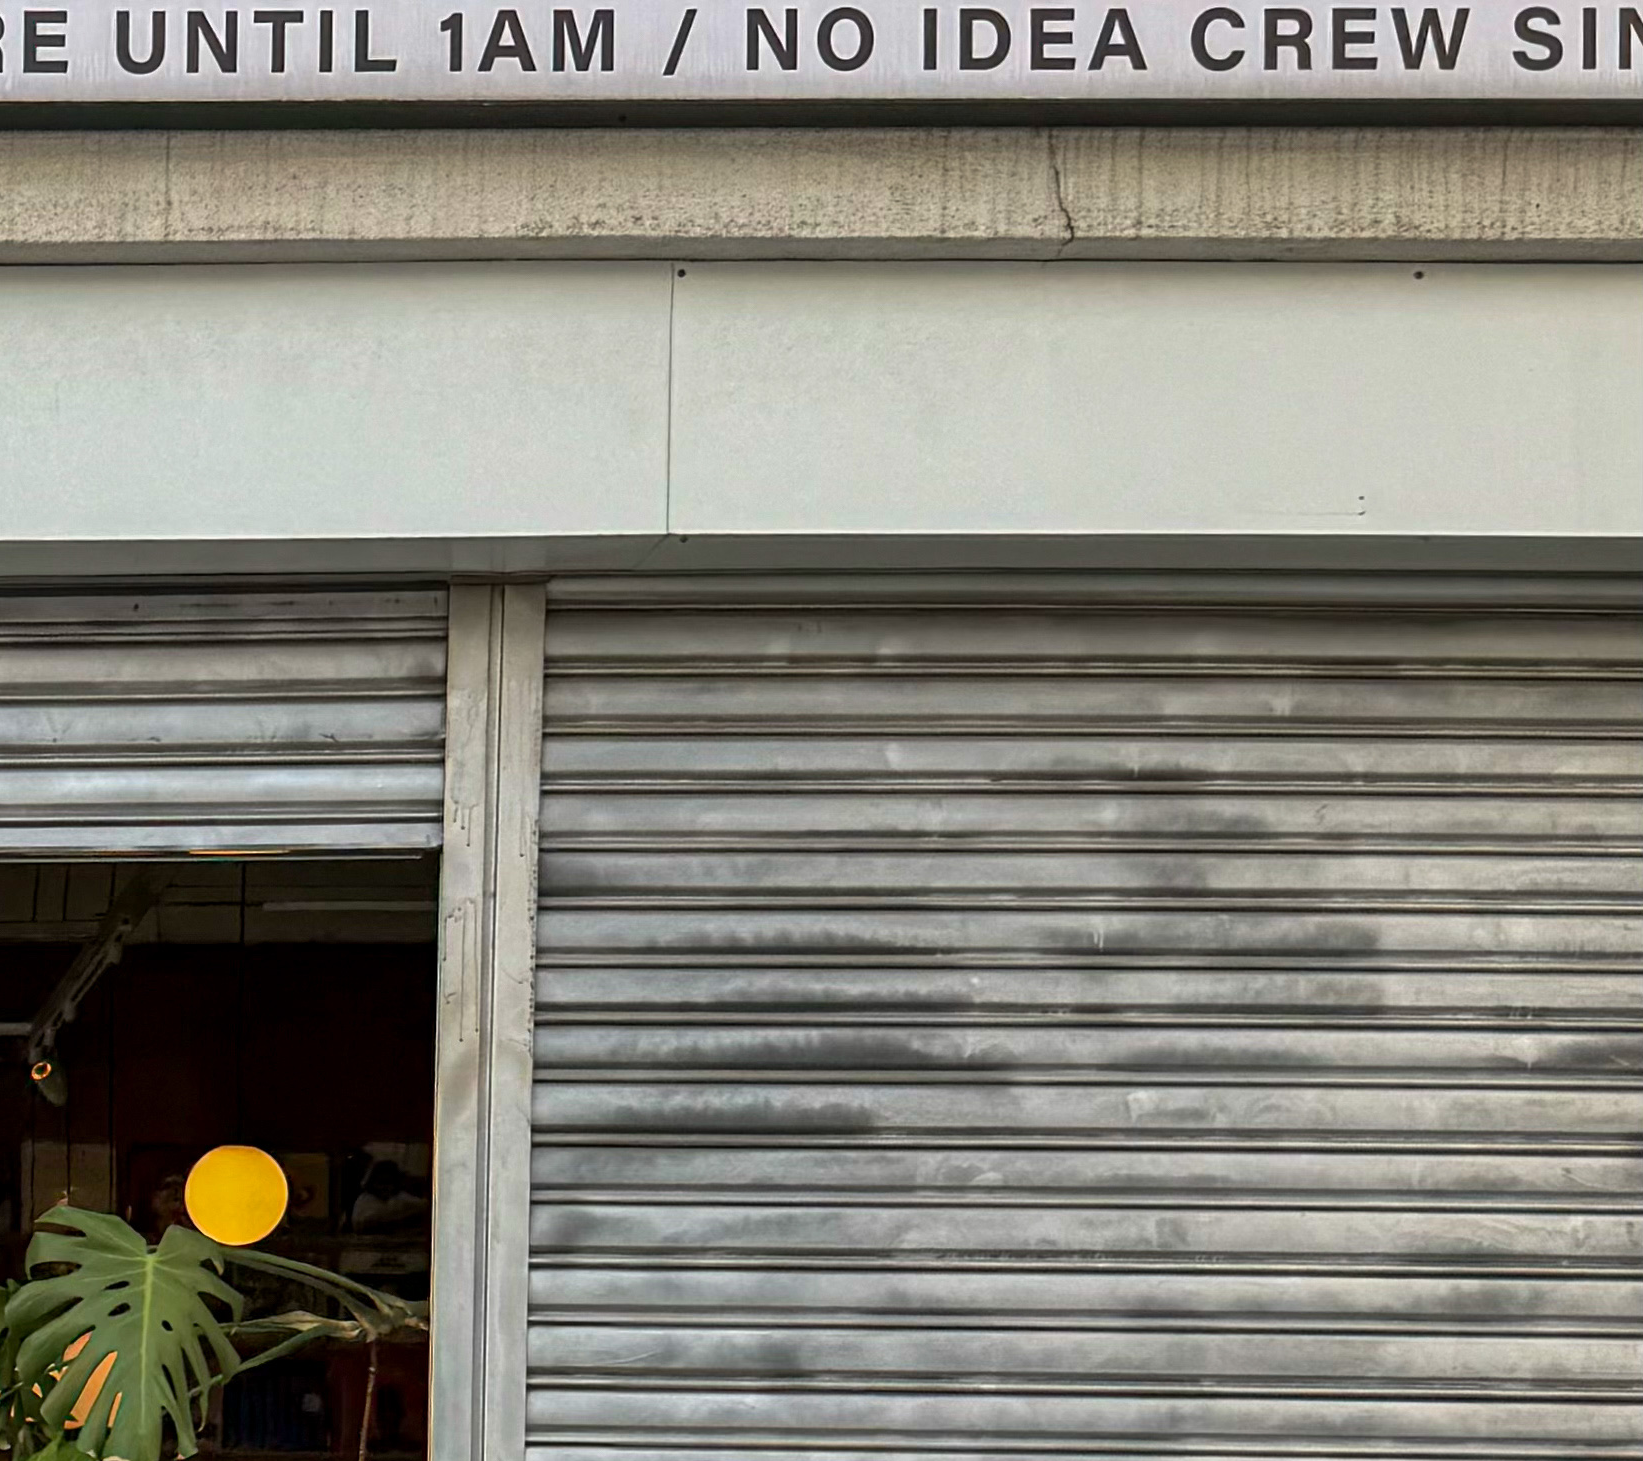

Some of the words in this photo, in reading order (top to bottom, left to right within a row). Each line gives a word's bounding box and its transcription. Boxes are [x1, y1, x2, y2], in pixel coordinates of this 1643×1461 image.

[117, 10, 397, 74] UNTIL
[441, 10, 614, 71] 1AM
[663, 9, 697, 75] /
[747, 7, 874, 71] NO
[924, 9, 1147, 70] IDEA
[1191, 8, 1469, 71] CREW
